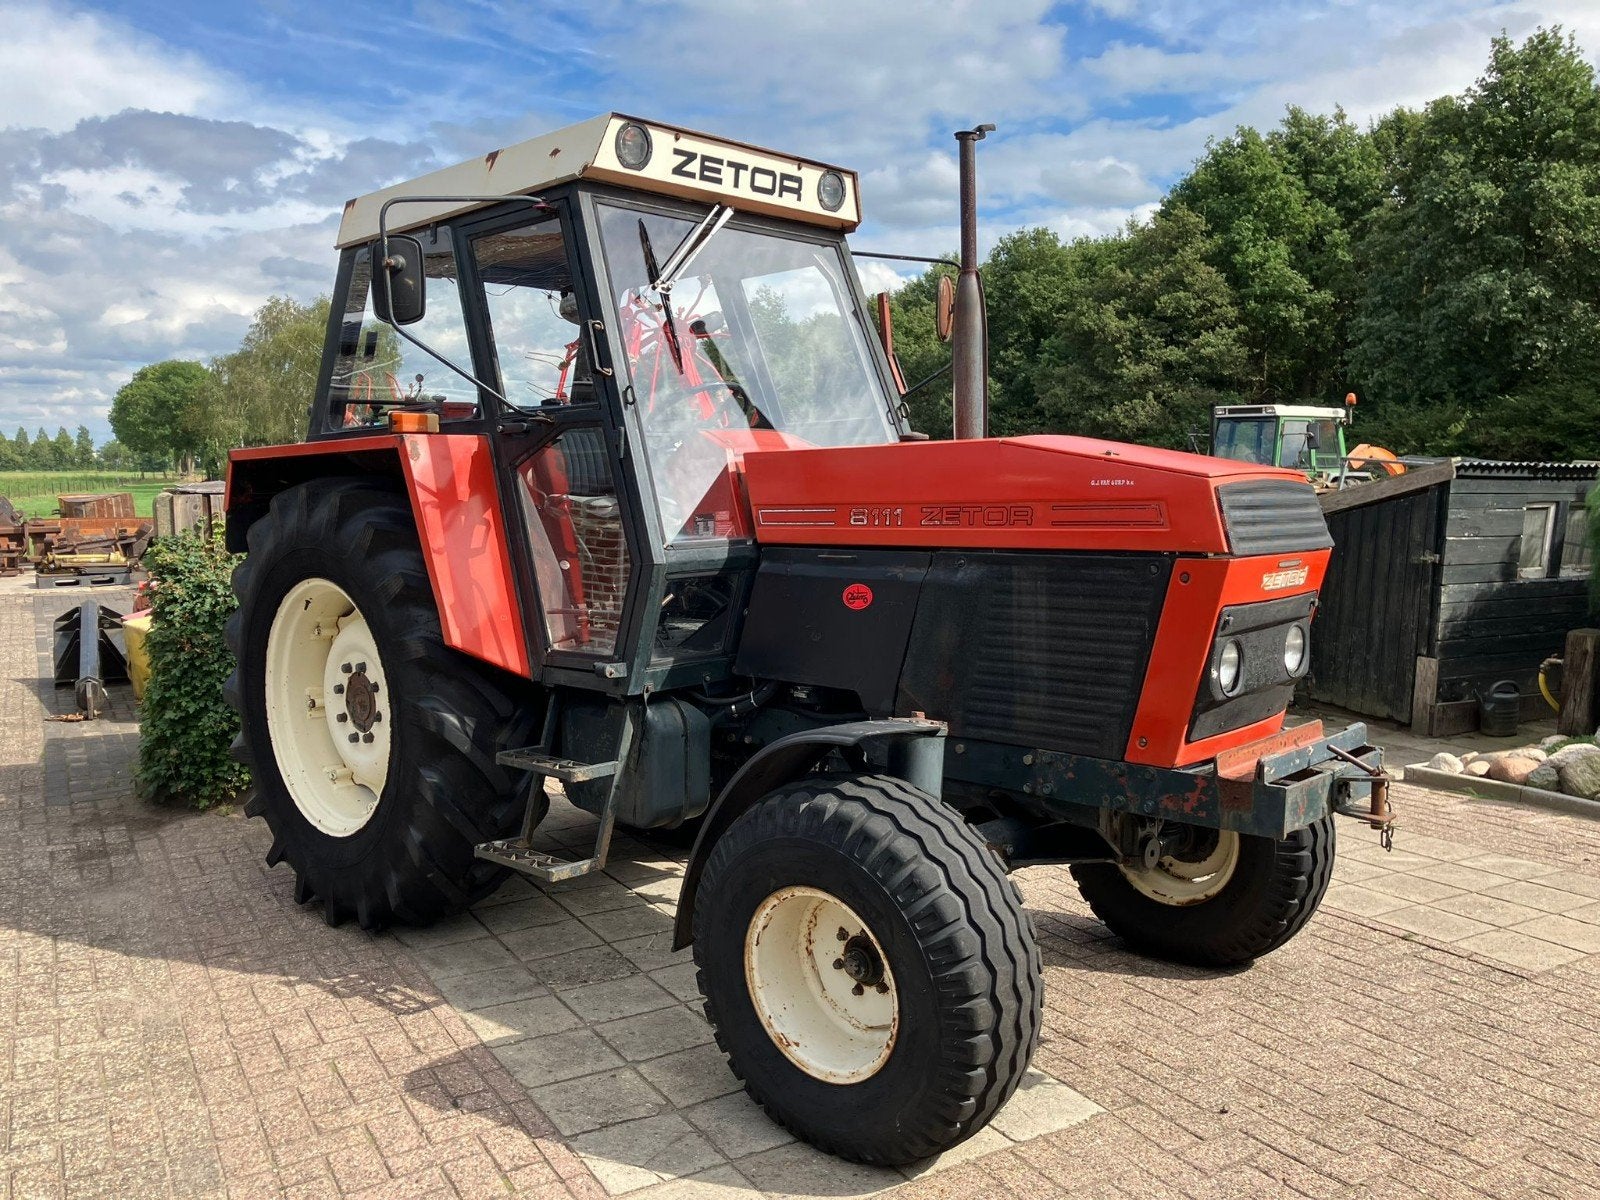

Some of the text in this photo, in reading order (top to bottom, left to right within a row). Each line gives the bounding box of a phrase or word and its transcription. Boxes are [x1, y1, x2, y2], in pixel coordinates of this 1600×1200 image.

[672, 148, 803, 202] ZETOR
[850, 506, 1034, 526] 8111 ZETOR
[1262, 567, 1308, 590] ZETOR
